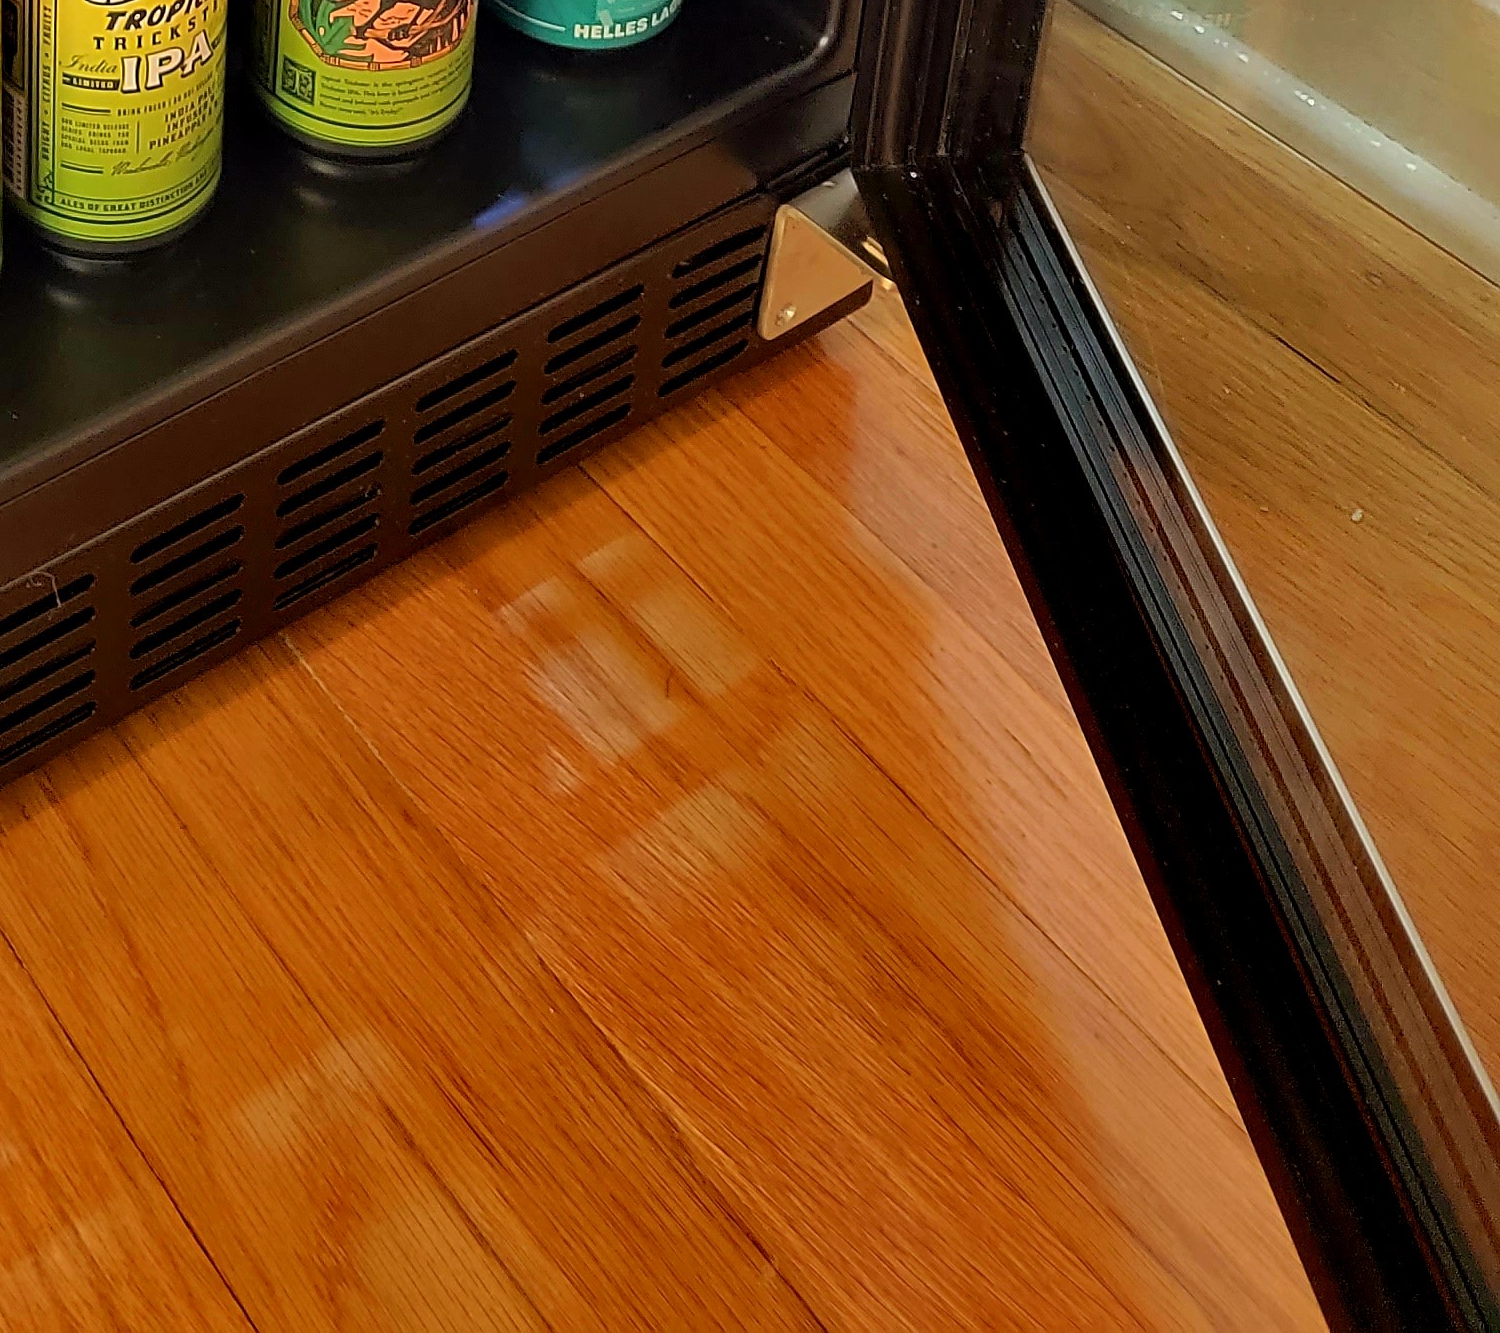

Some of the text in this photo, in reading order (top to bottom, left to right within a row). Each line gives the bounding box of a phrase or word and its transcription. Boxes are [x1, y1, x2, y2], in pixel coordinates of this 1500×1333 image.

[574, 17, 648, 39] HELLES
[59, 55, 117, 74] India
[121, 29, 212, 94] IPA
[165, 103, 195, 122] INDIA
[61, 199, 84, 209] ALES
[103, 203, 135, 211] GREAT
[139, 183, 195, 210] DISTINCTION
